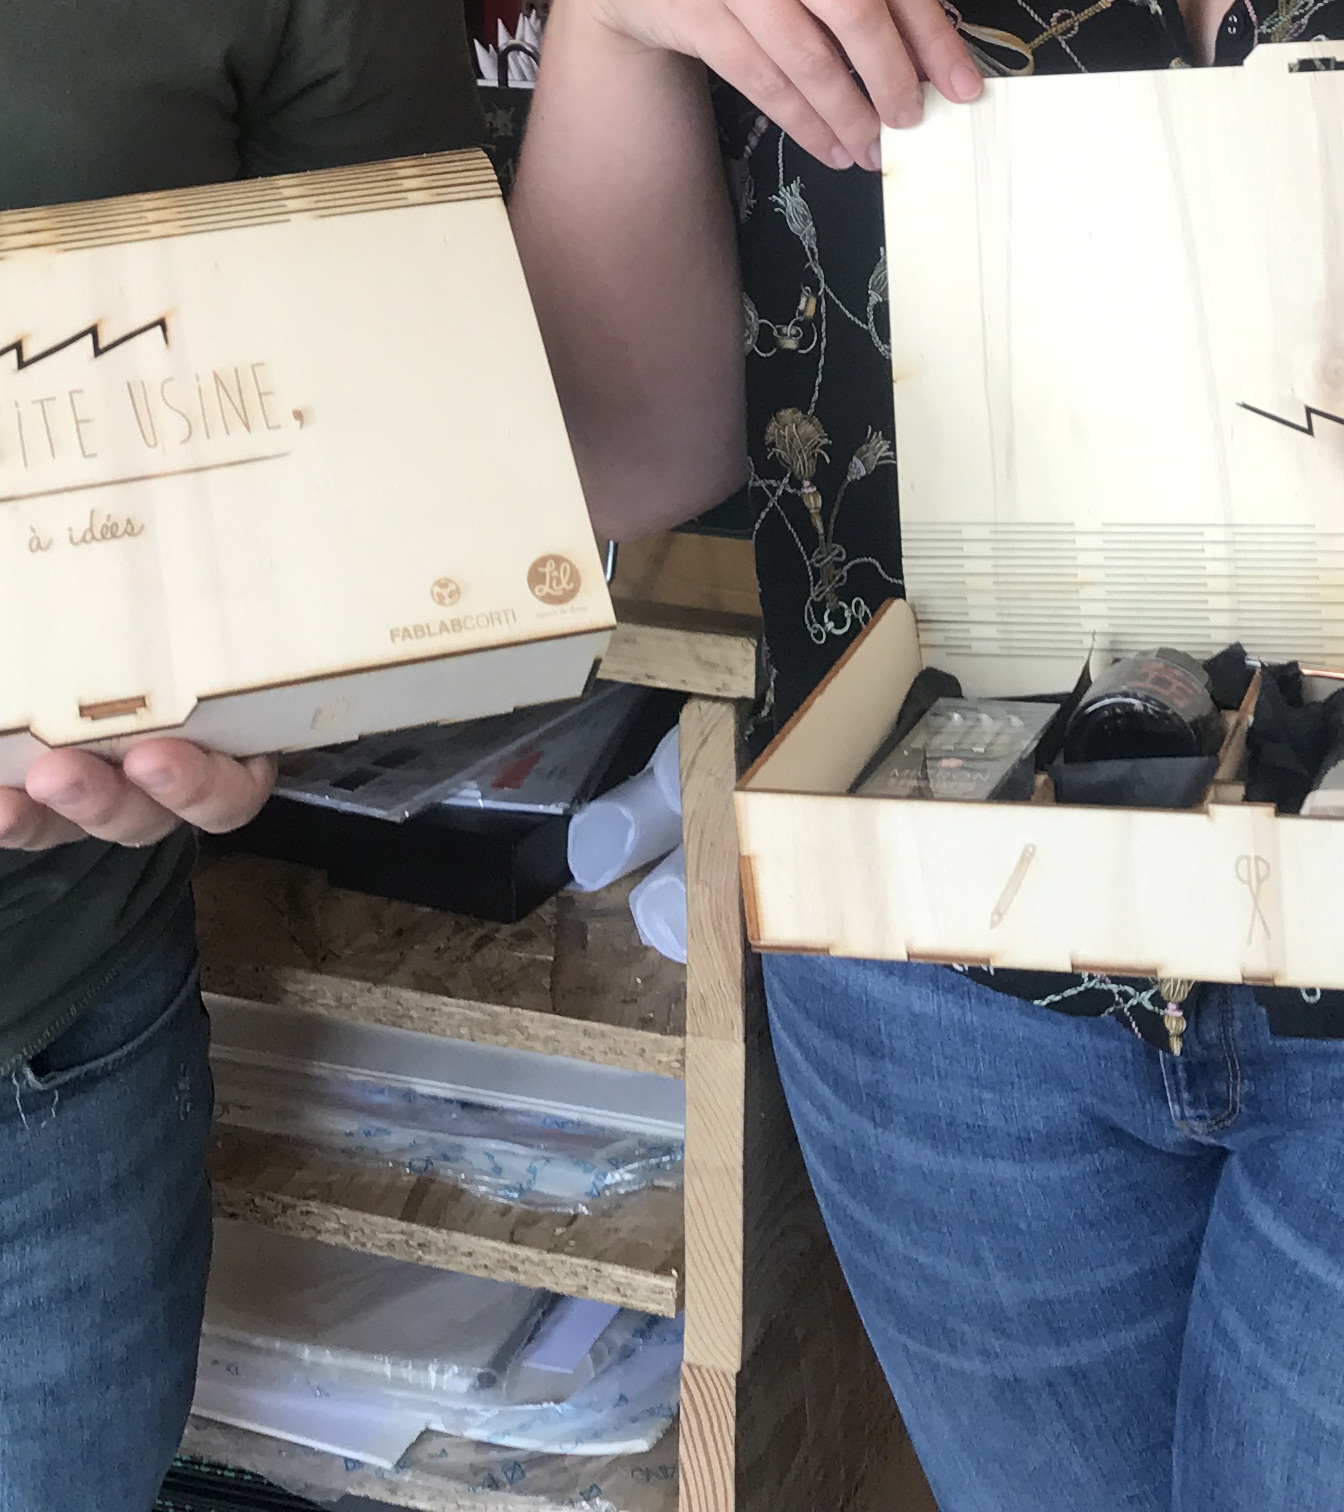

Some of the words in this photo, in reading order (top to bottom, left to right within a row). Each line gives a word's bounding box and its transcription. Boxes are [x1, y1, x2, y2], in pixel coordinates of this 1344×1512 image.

[28, 525, 53, 554] à
[67, 508, 145, 548] idées
[388, 607, 518, 645] FABLABCORTI
